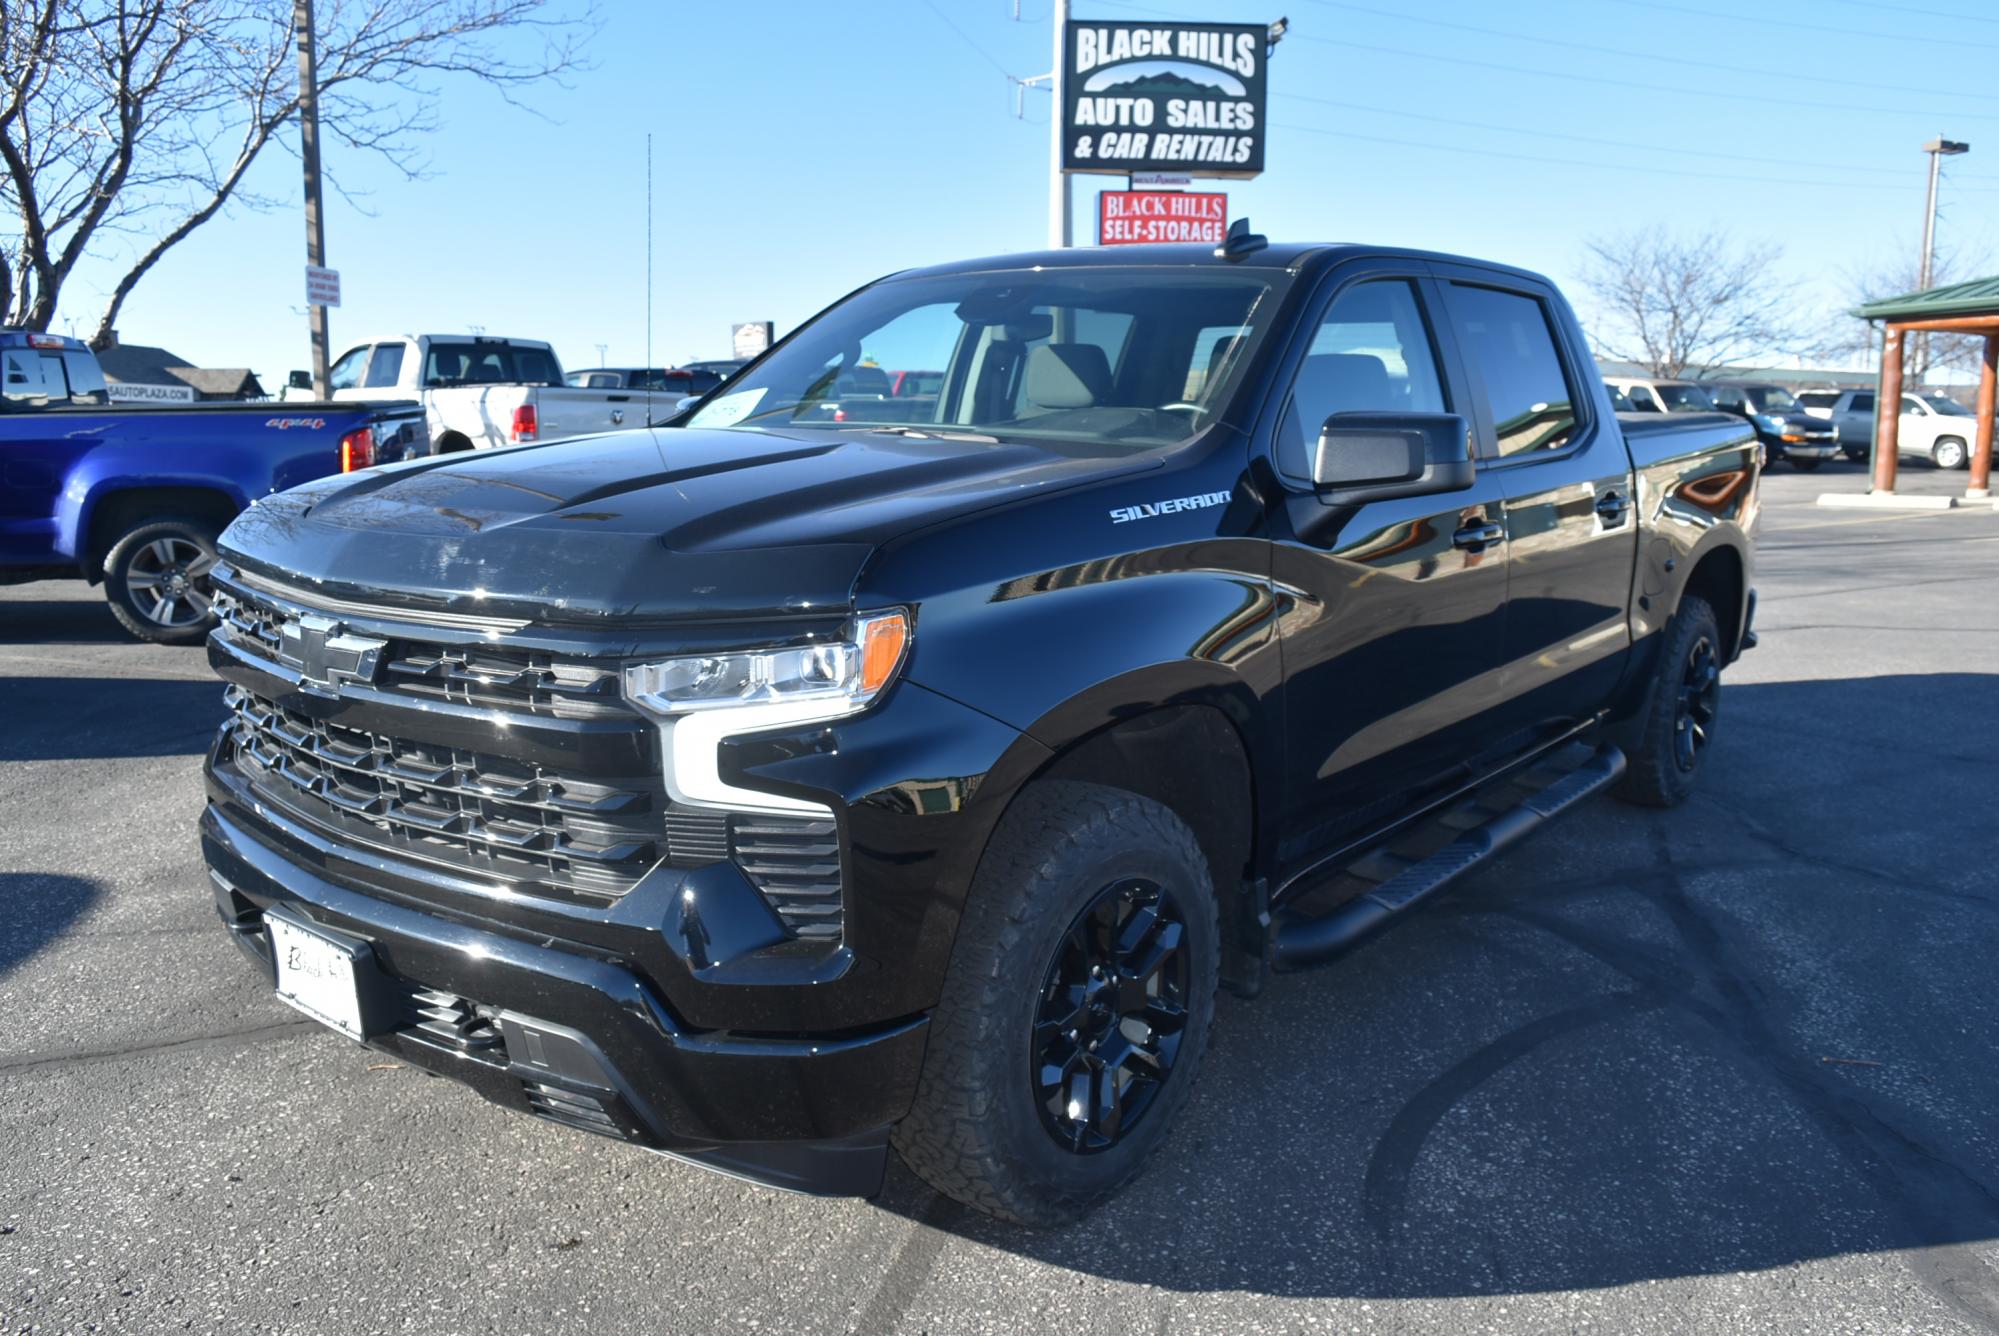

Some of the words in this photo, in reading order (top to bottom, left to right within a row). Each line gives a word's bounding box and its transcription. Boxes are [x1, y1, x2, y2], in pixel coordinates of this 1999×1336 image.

[1076, 29, 1173, 74] BLACK
[1177, 31, 1256, 78] HILLS
[1074, 97, 1154, 126] AUTO
[1166, 99, 1255, 130] SALES
[1074, 135, 1093, 158] &
[1097, 132, 1149, 159] CAR
[1150, 133, 1253, 163] RENTALS
[1106, 195, 1167, 217] BLACK
[1170, 197, 1222, 220] HILLS
[1104, 219, 1223, 241] SELF-STORAGE
[1109, 490, 1232, 524] SILVERADO
